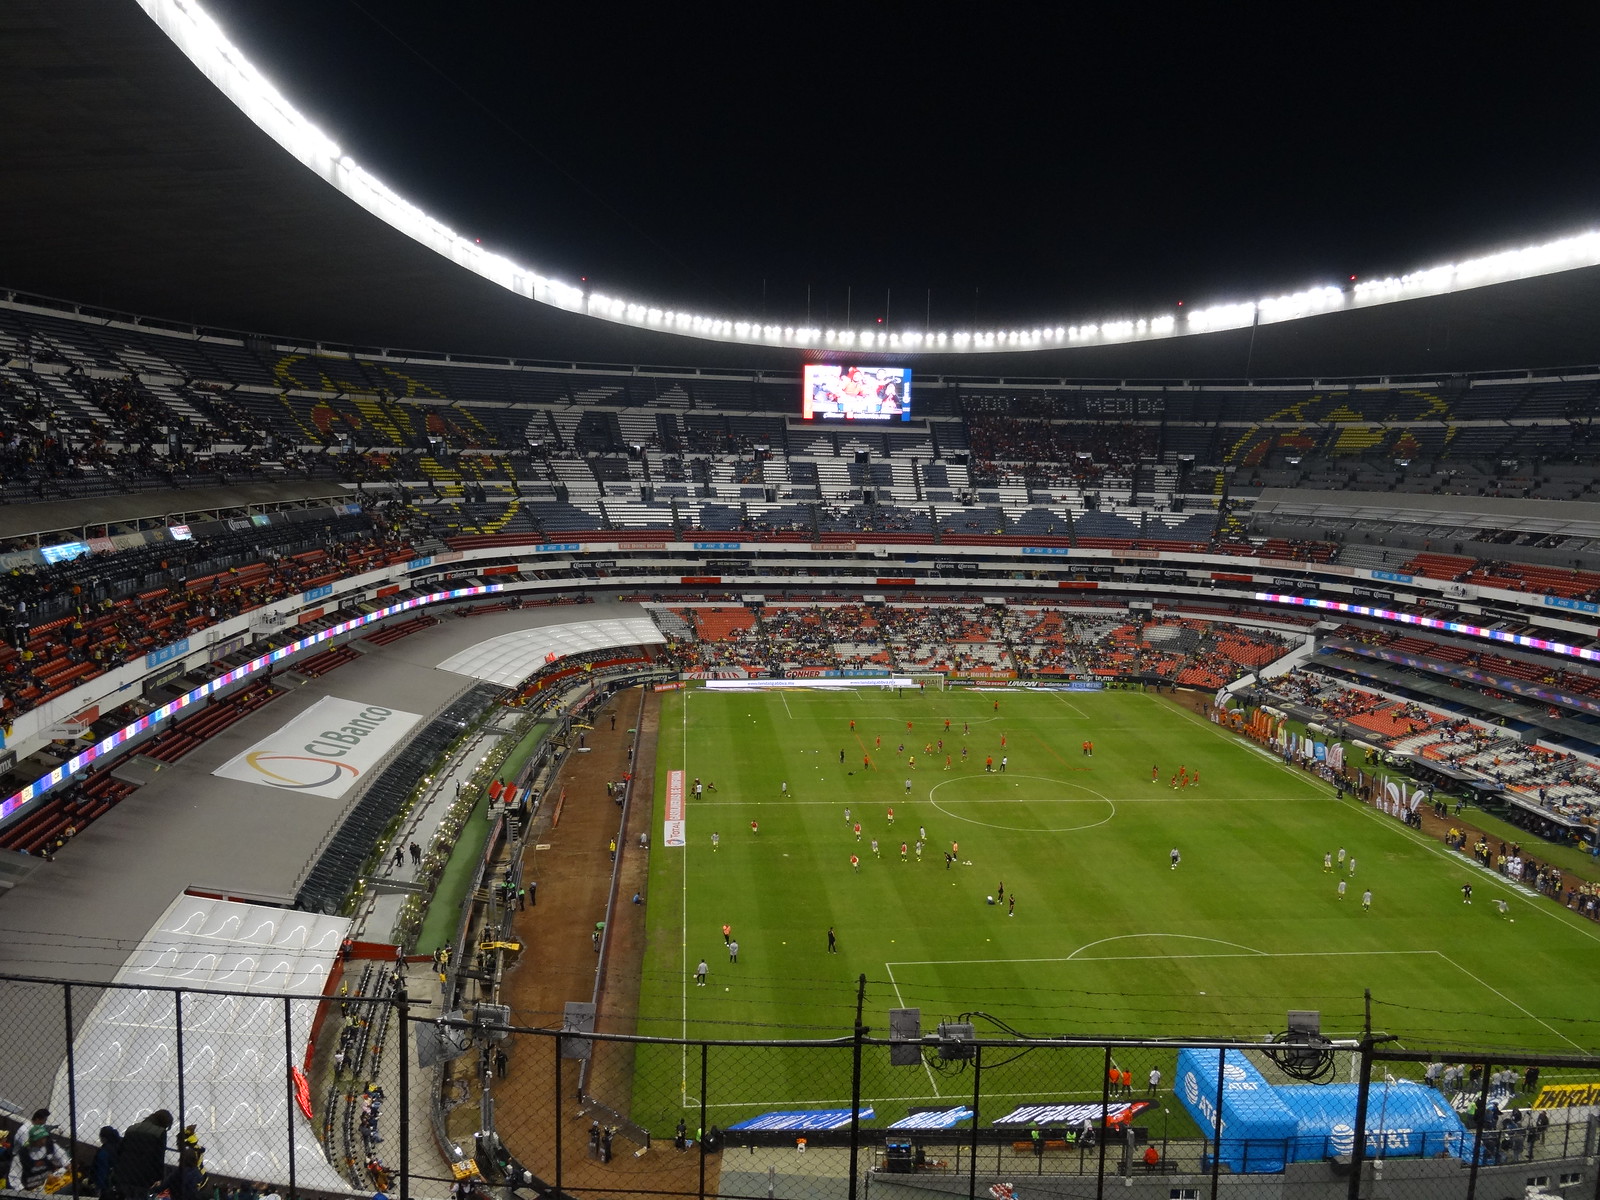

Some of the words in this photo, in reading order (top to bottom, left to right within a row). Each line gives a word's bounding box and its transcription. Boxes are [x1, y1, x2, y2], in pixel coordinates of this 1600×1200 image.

[228, 519, 250, 532] Corona
[451, 571, 476, 579] caliente.mx
[1274, 578, 1294, 587] Corona
[1297, 580, 1316, 589] Corona
[1354, 588, 1370, 597] Corona
[1373, 591, 1390, 600] Corona
[1425, 600, 1455, 611] caliente.mx
[1583, 603, 1595, 611] AT&T
[786, 670, 820, 678] GONHER
[304, 706, 393, 758] CIBanco
[1365, 1128, 1413, 1150] AT&T
